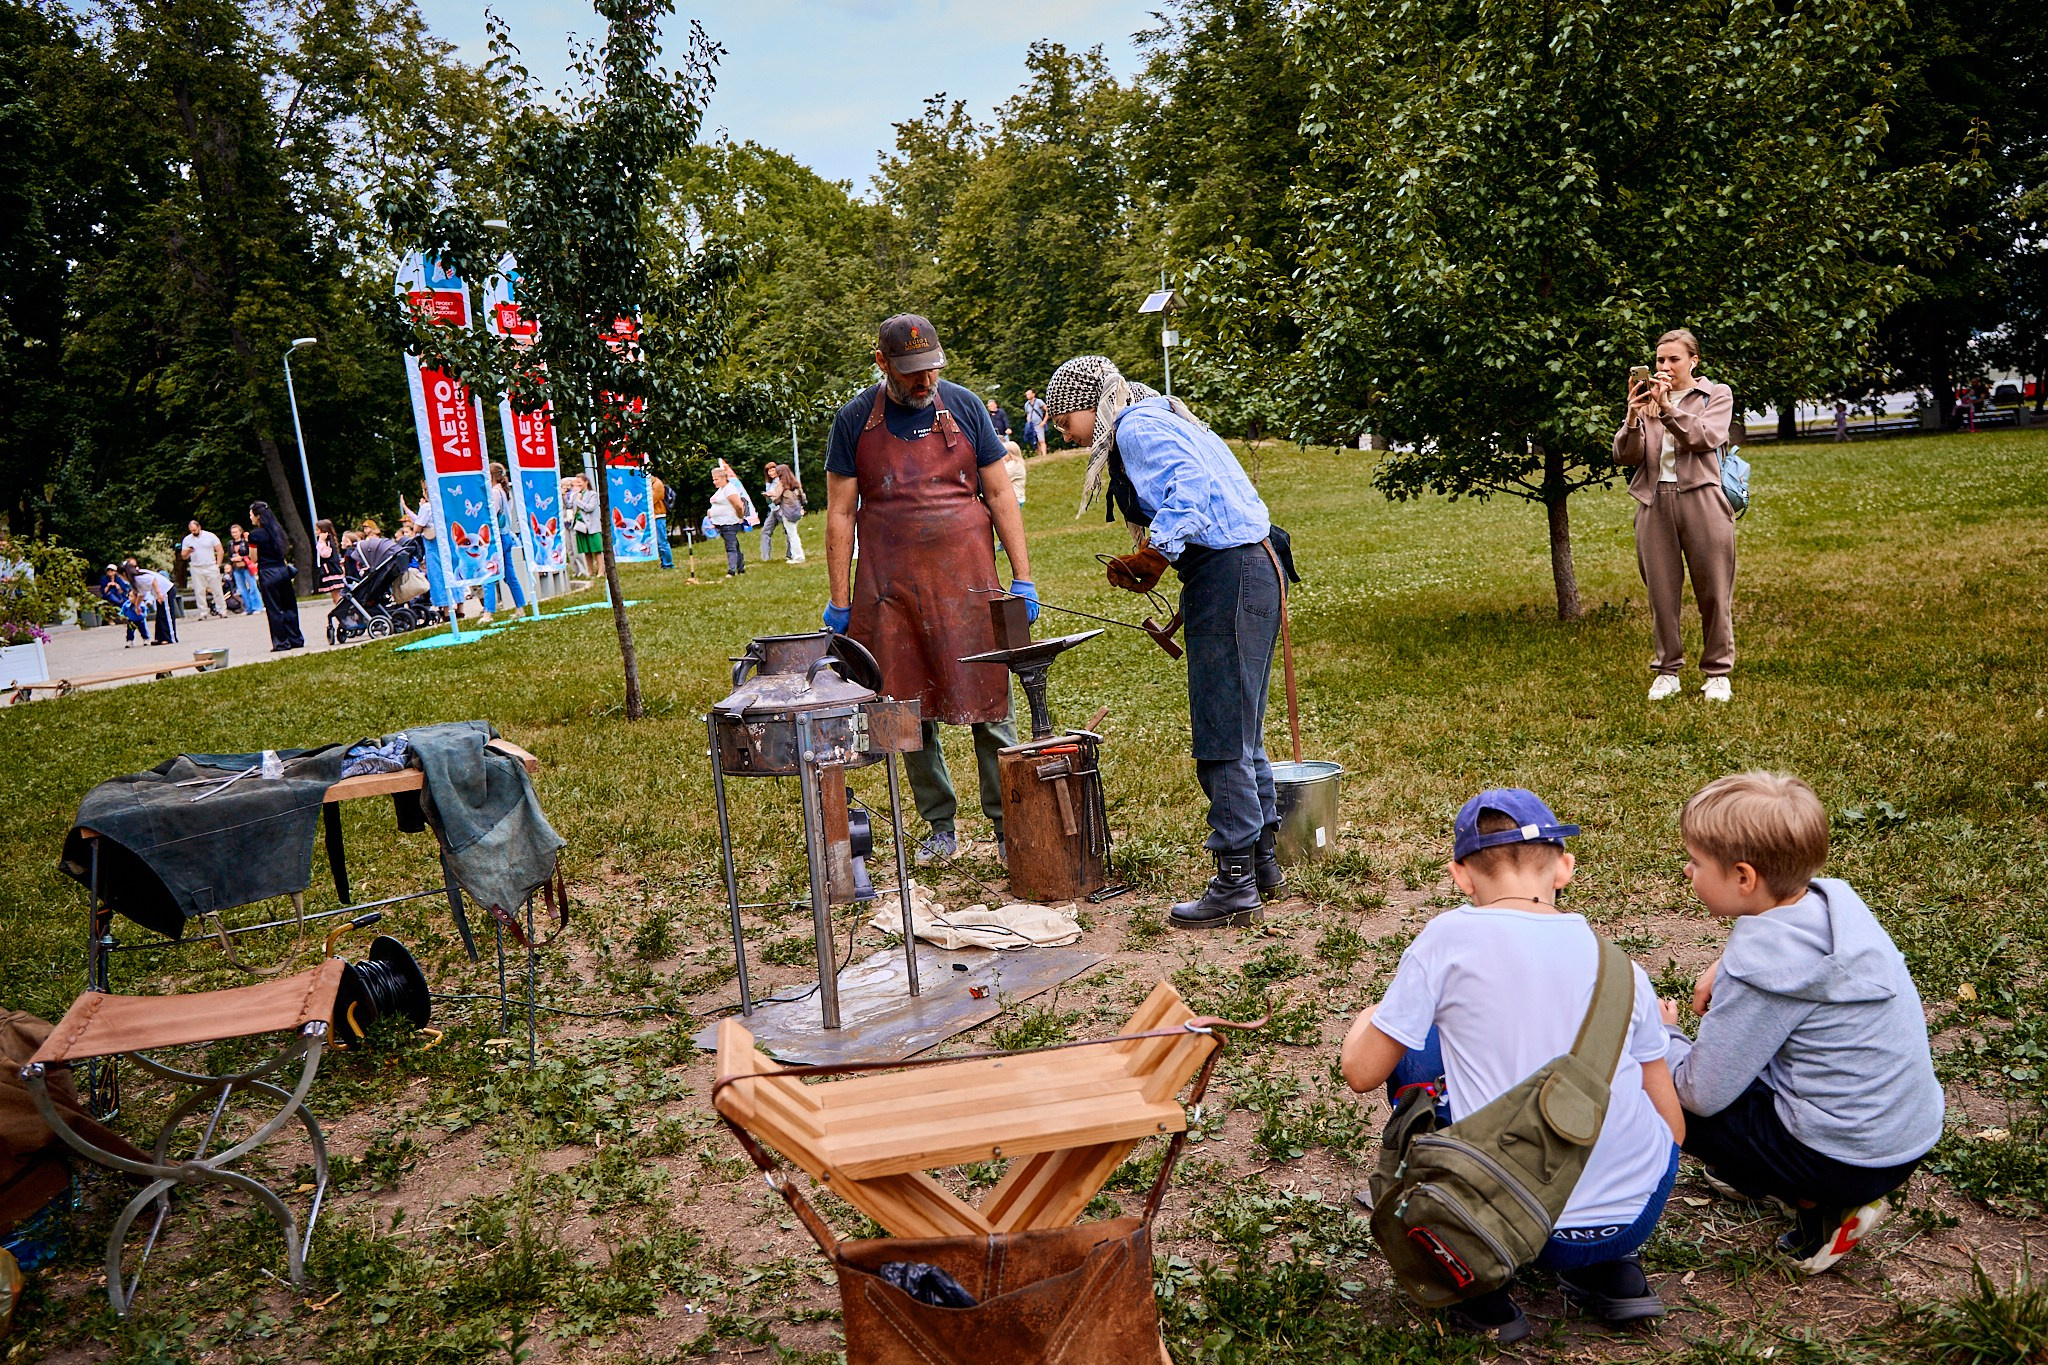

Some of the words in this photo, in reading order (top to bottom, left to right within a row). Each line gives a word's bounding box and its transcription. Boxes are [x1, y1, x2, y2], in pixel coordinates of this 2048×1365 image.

[434, 380, 462, 457] ЛЕТО
[462, 447, 472, 457] В
[536, 446, 547, 456] В
